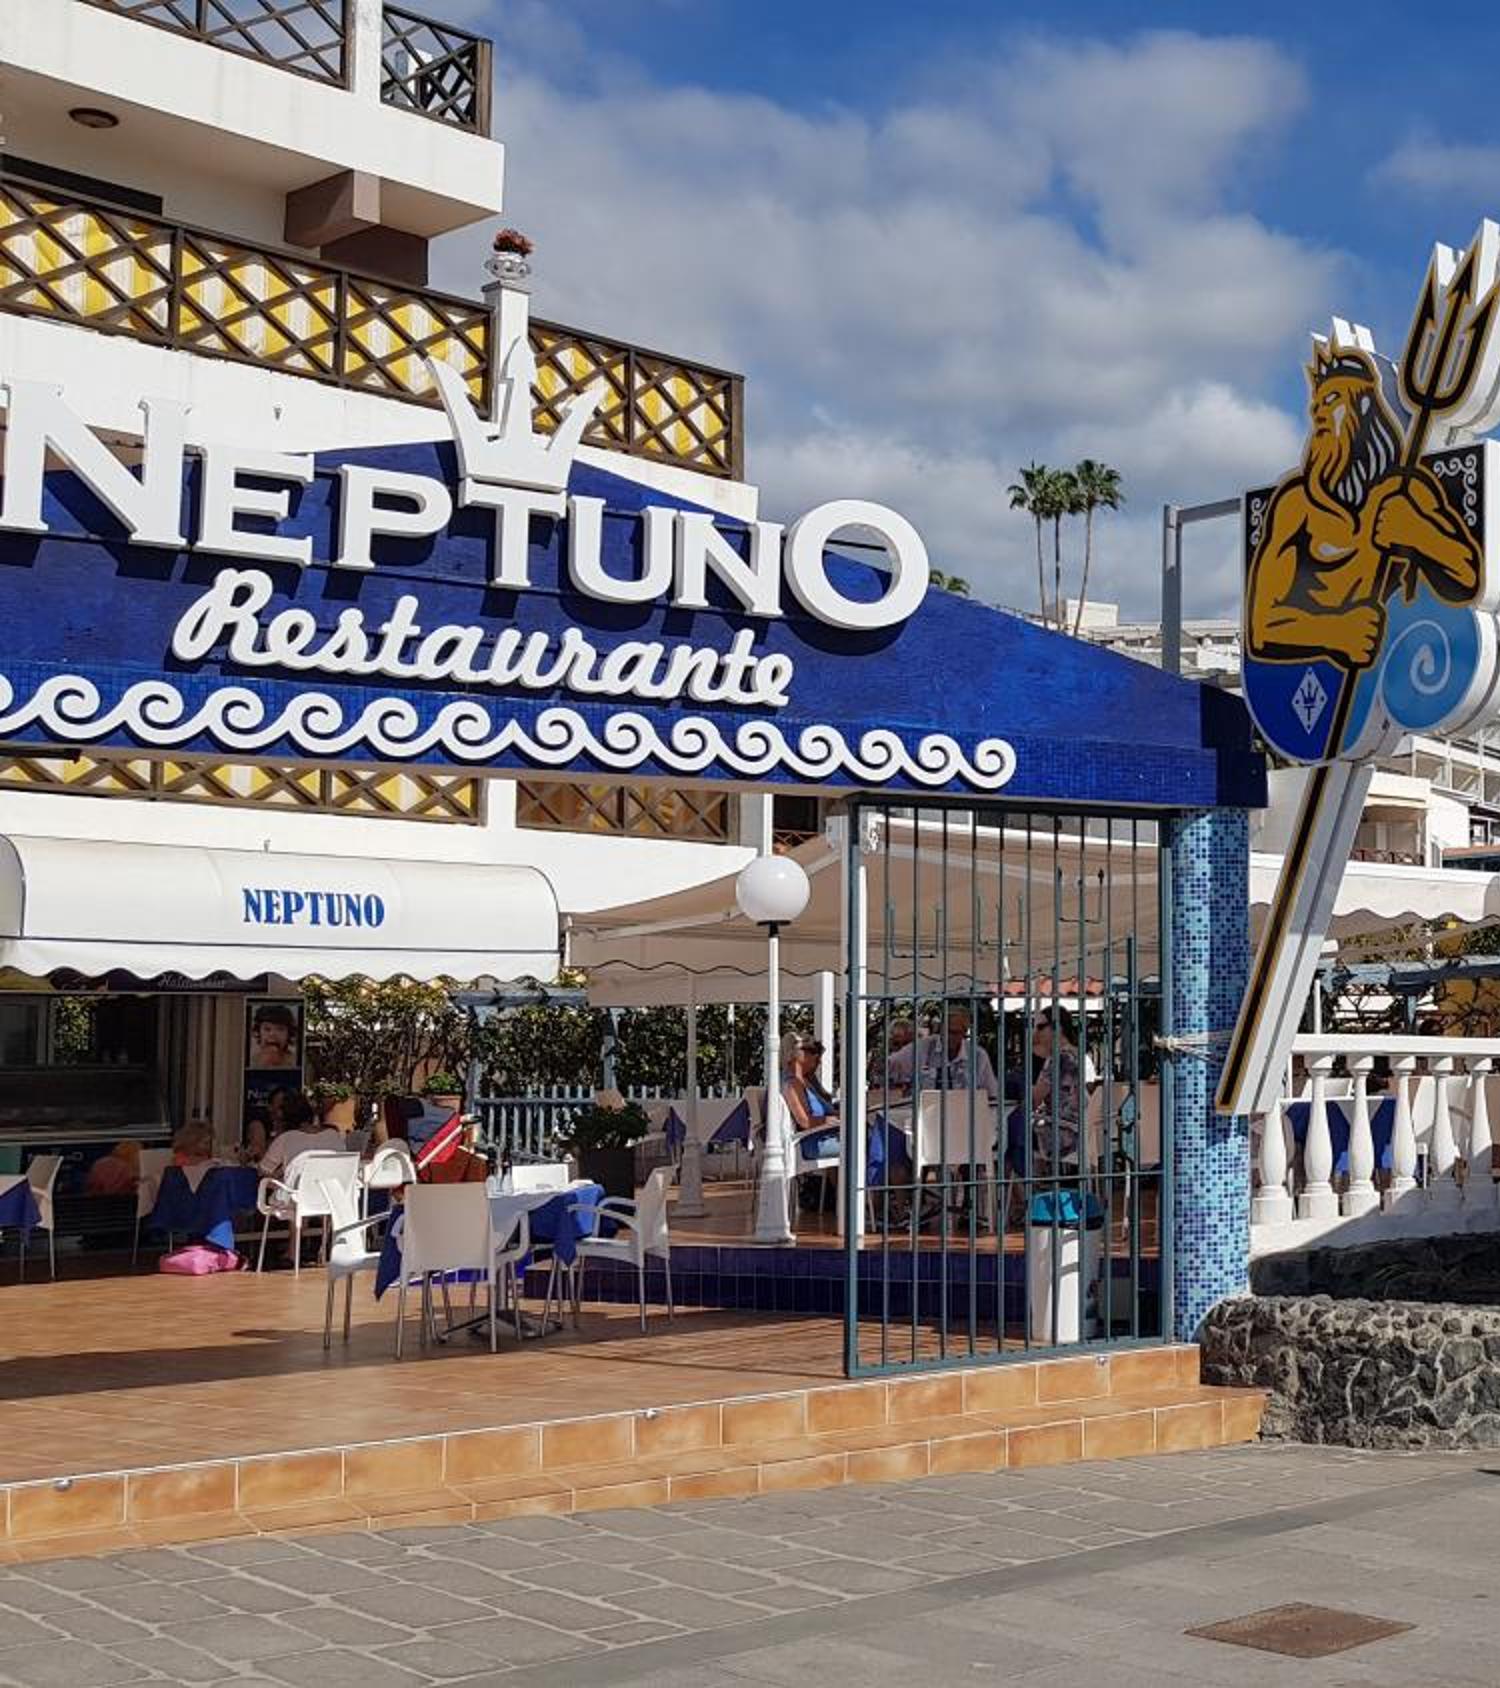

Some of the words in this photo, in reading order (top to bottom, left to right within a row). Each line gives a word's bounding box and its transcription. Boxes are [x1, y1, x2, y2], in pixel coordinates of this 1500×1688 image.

[0, 380, 931, 630] NEPTUNO
[171, 568, 796, 709] Restaurante
[242, 888, 385, 928] NEPTUNO
